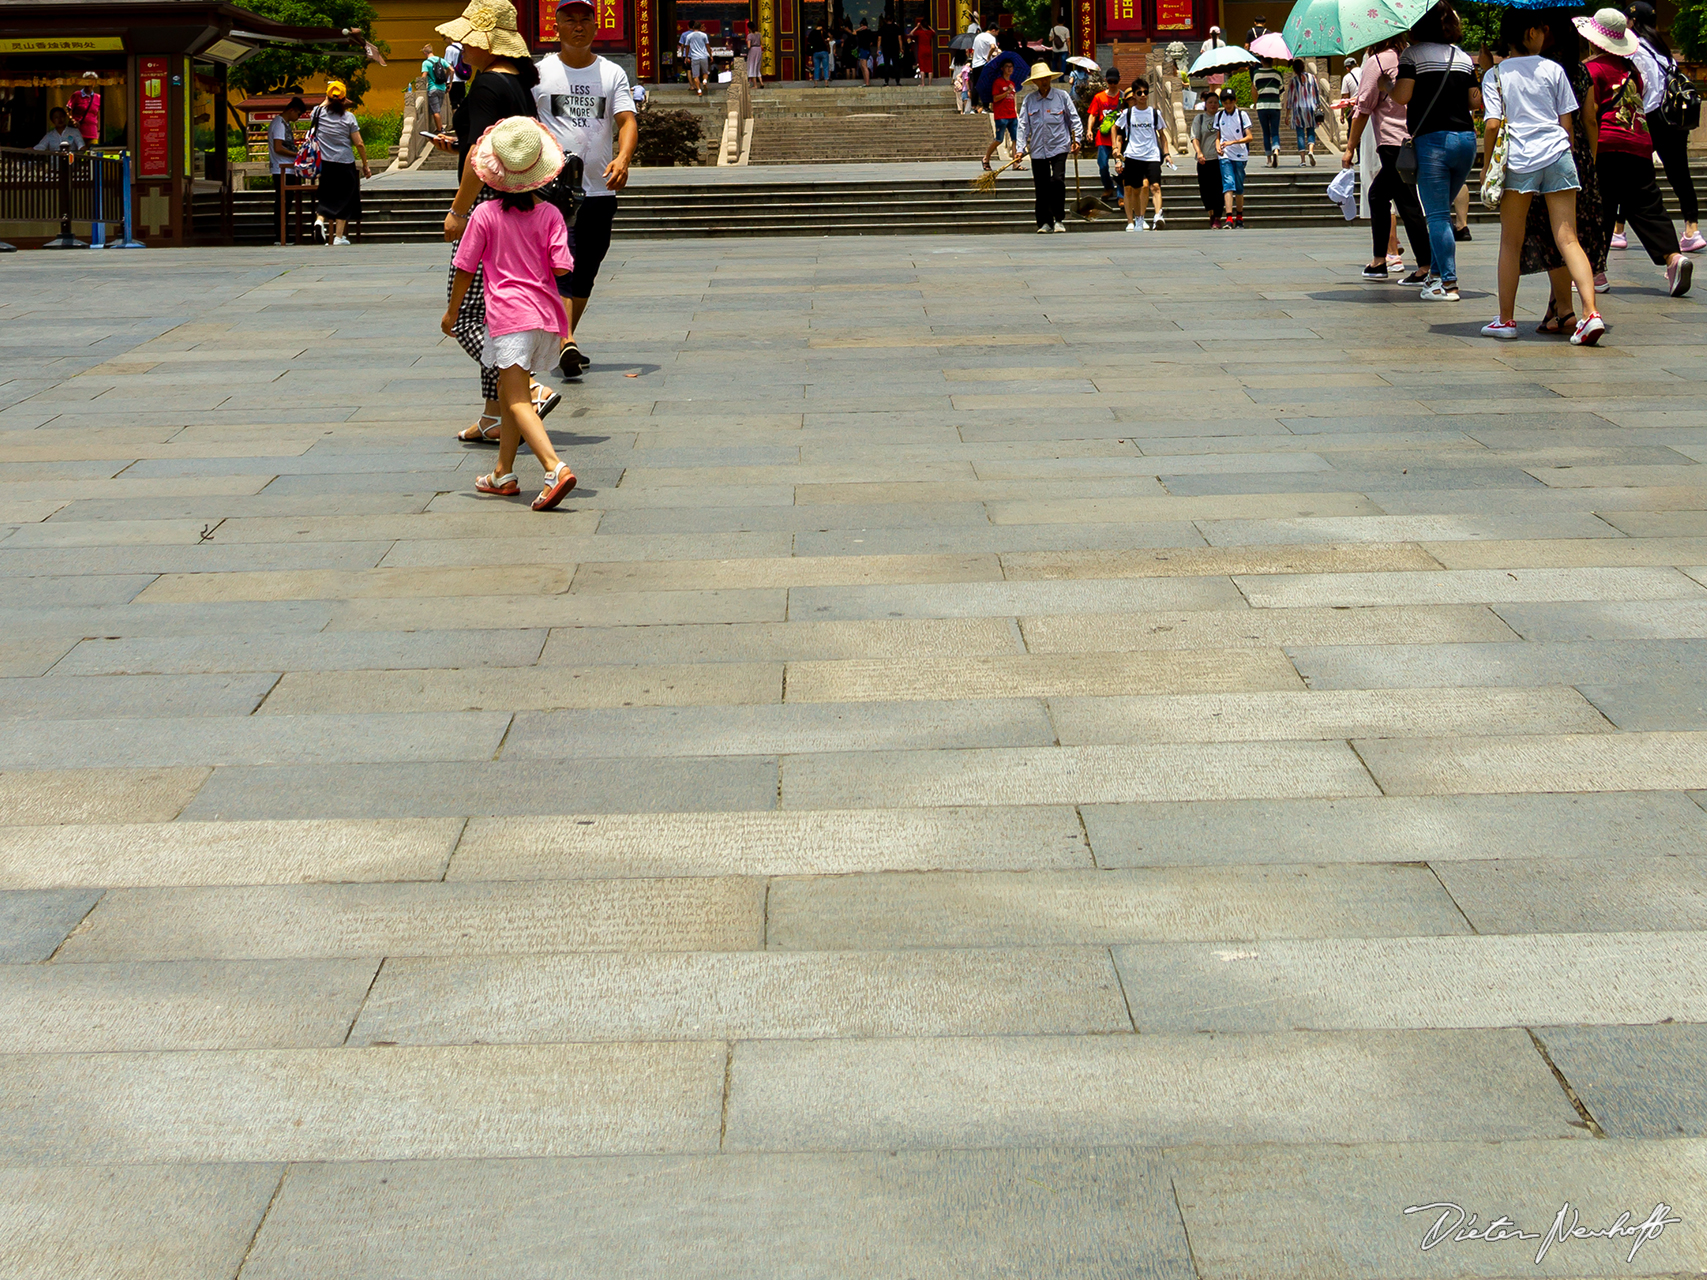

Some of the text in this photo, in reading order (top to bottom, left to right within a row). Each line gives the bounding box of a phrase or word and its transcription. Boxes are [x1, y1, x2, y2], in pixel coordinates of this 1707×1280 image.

[570, 84, 591, 95] LESS
[563, 95, 595, 107] STRESS
[569, 107, 591, 118] MORE
[571, 118, 591, 128] SEX.
